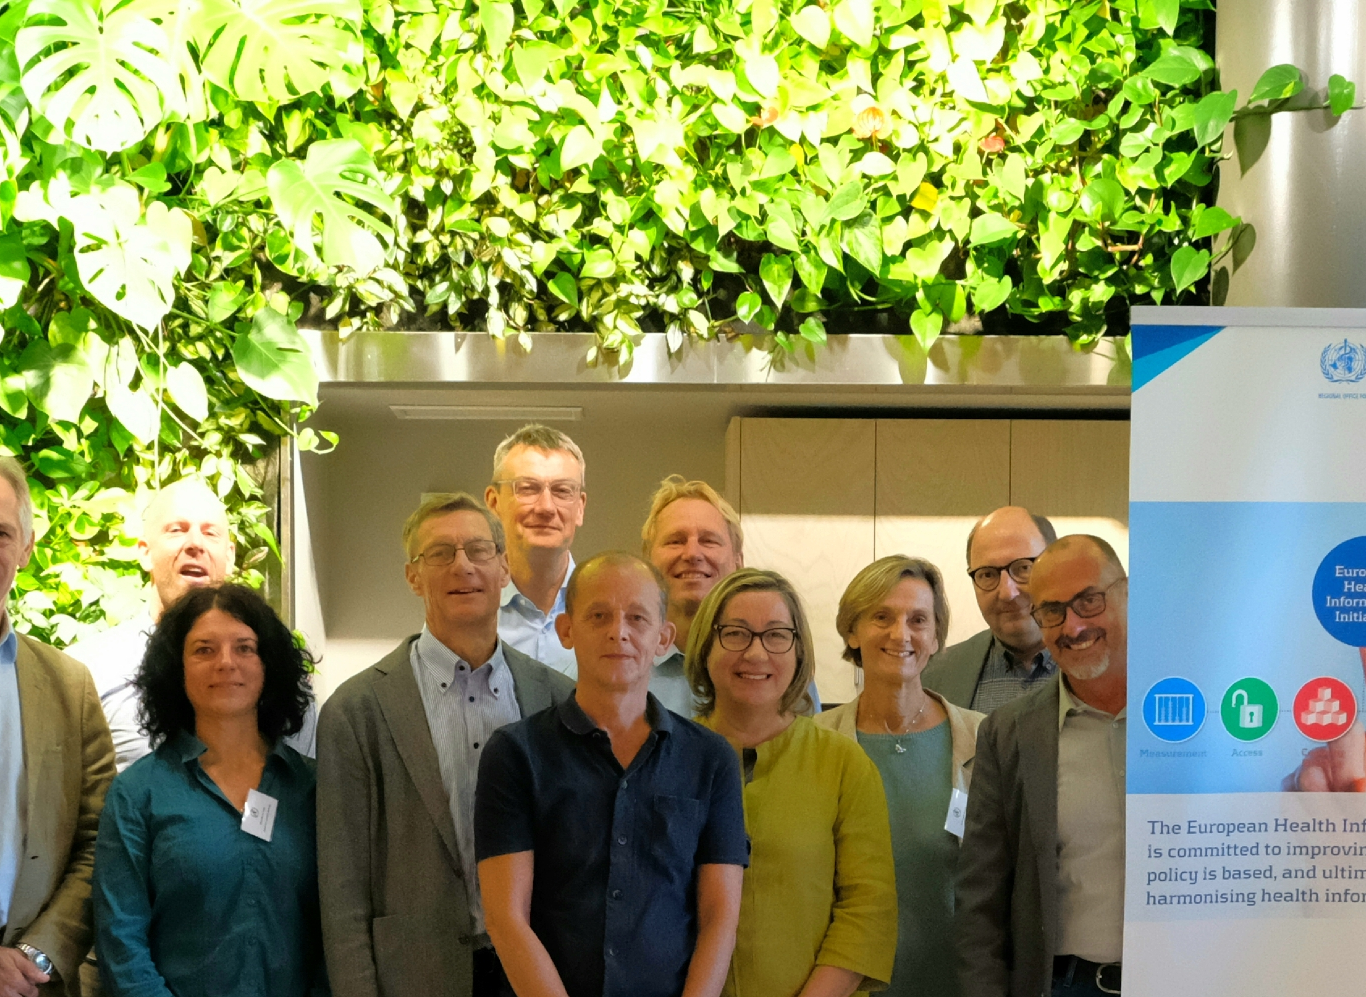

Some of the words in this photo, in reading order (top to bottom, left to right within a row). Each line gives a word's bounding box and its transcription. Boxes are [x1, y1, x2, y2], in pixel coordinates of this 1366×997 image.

[1139, 749, 1207, 758] Measurement
[1231, 748, 1263, 757] Access
[1147, 820, 1182, 835] The
[1186, 819, 1268, 836] European
[1274, 818, 1336, 833] Health
[1147, 844, 1163, 858] is
[1167, 842, 1260, 858] committed
[1264, 844, 1282, 856] to
[1146, 867, 1199, 885] policy
[1202, 866, 1217, 881] is
[1222, 865, 1277, 881] based,
[1282, 865, 1317, 879] and
[1146, 890, 1257, 906] harmonising
[1261, 889, 1319, 903] health
